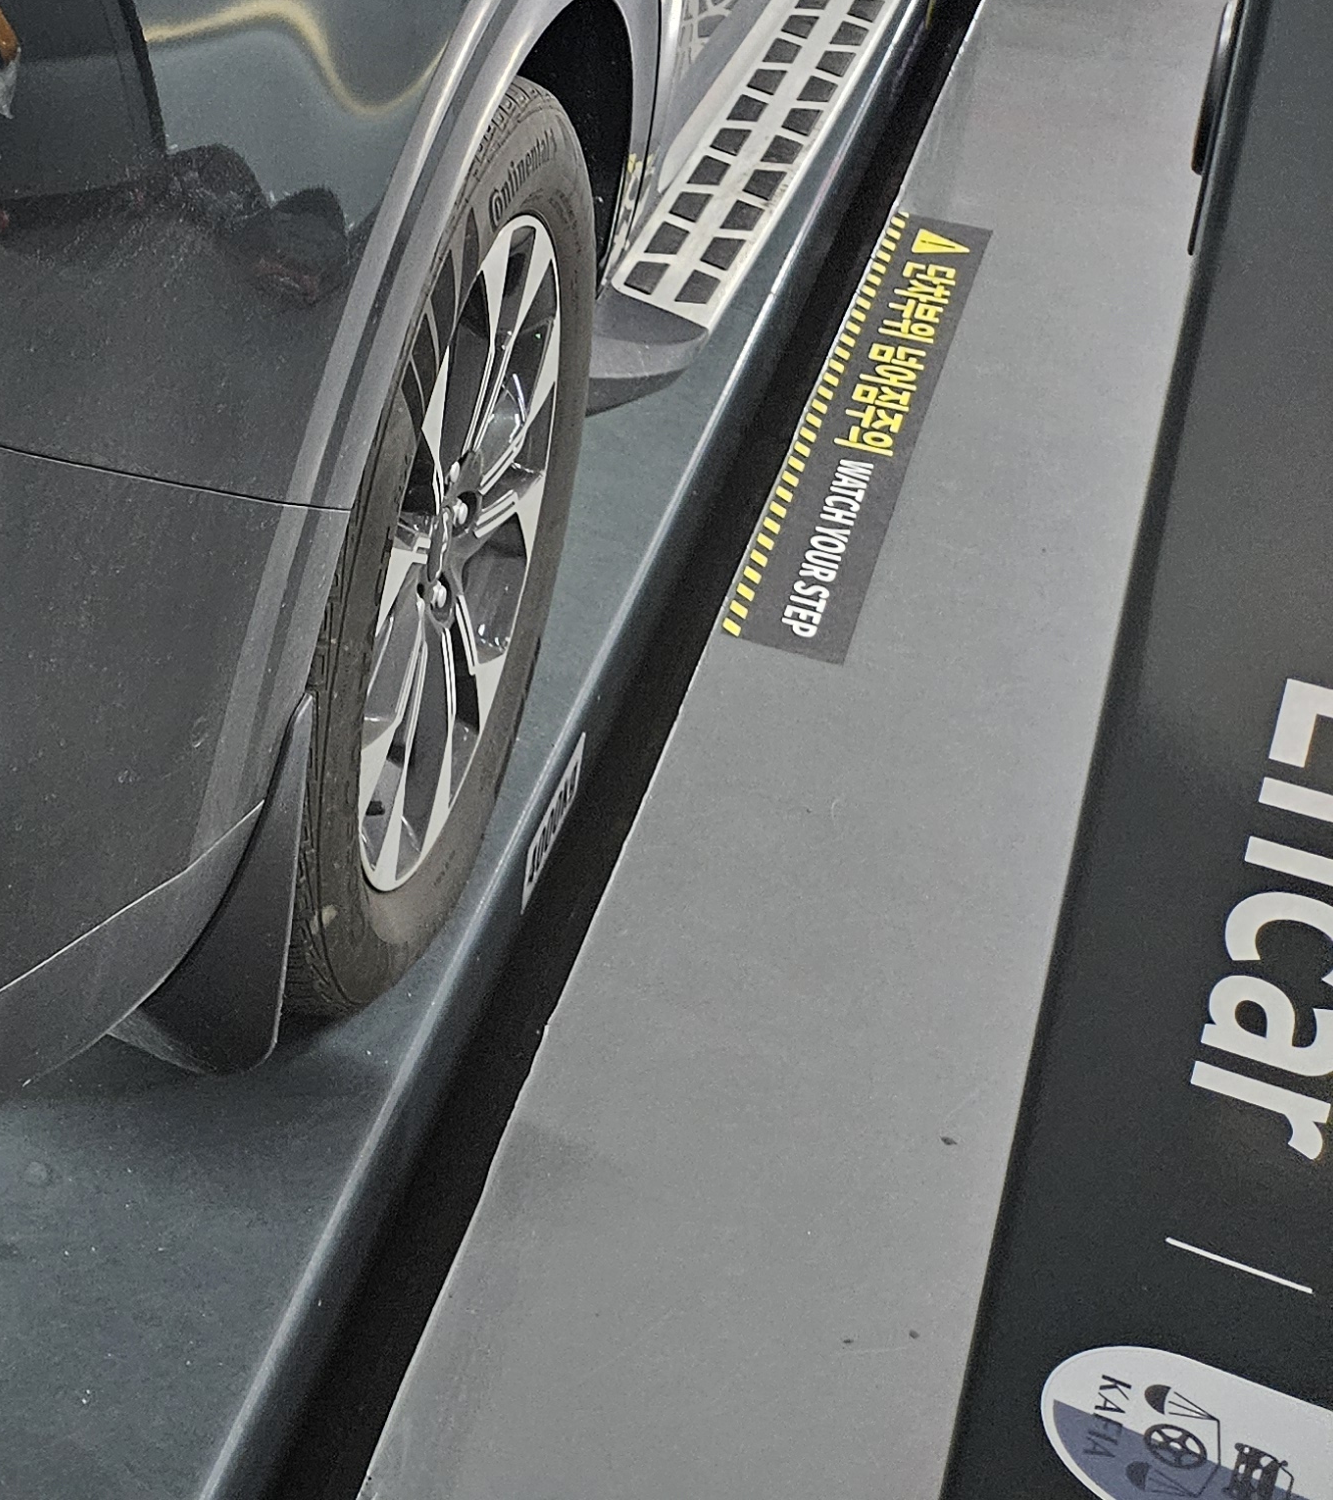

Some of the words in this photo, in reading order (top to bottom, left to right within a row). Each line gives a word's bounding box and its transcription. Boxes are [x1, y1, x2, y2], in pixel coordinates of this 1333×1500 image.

[878, 262, 956, 342] 단차부위
[834, 342, 927, 457] 넘어짐주의
[819, 457, 874, 529] WATCH
[798, 522, 854, 583] YOUR
[782, 580, 830, 639] STEP
[1082, 1374, 1132, 1460] KAFIA
